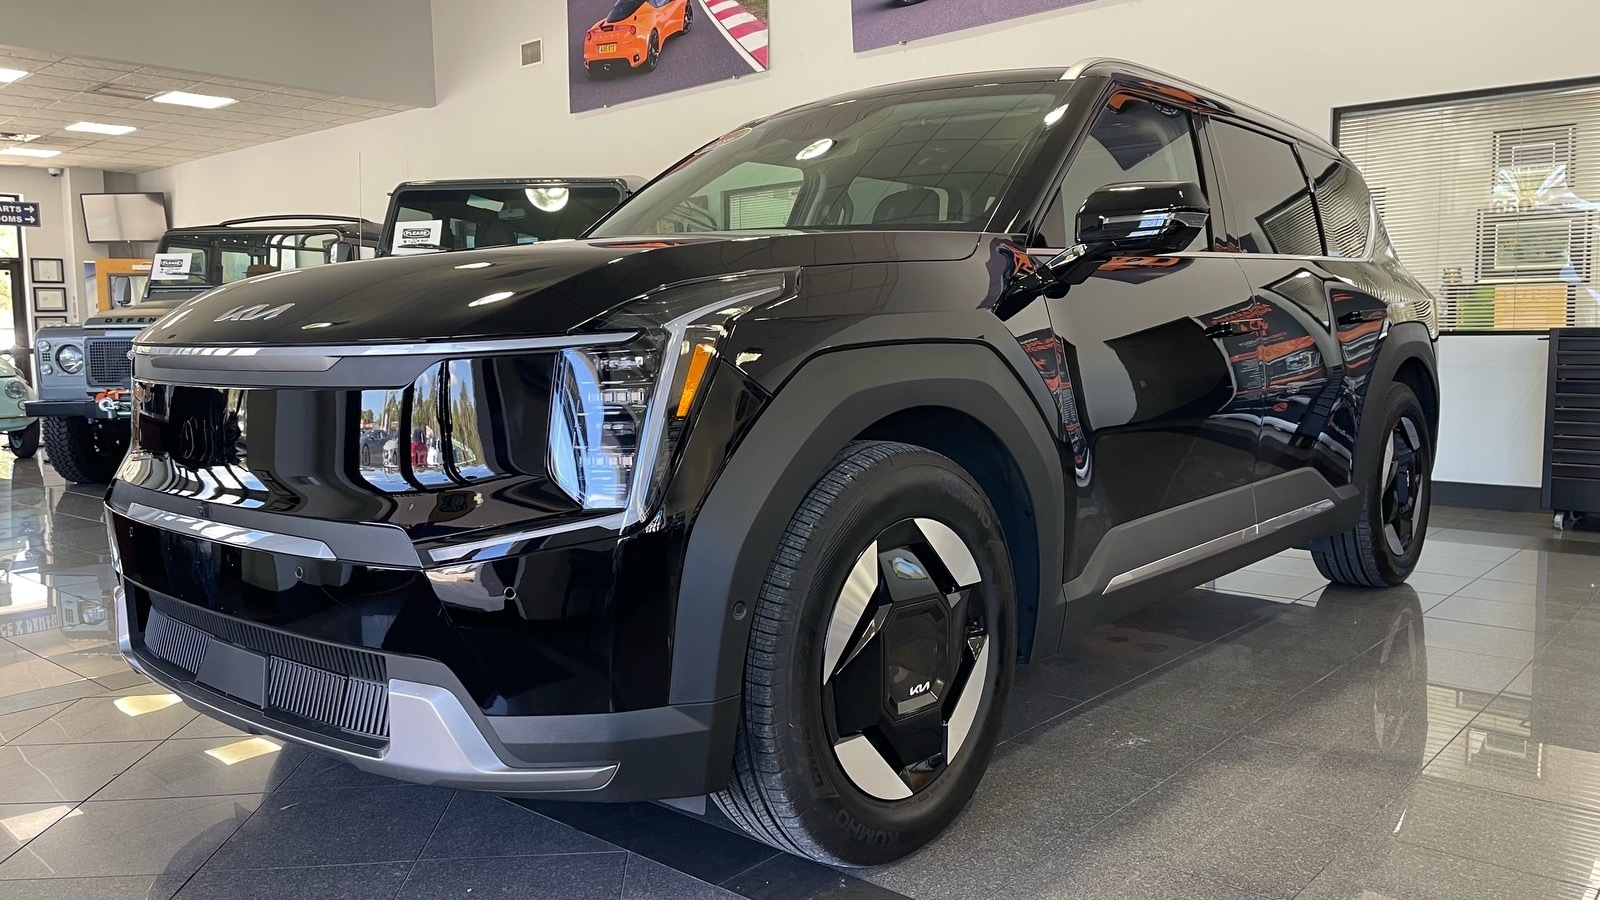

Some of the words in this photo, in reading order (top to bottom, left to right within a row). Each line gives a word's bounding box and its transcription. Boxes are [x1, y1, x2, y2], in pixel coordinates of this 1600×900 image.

[0, 215, 23, 223] OMS
[213, 302, 295, 322] KIA
[909, 681, 930, 696] KIA
